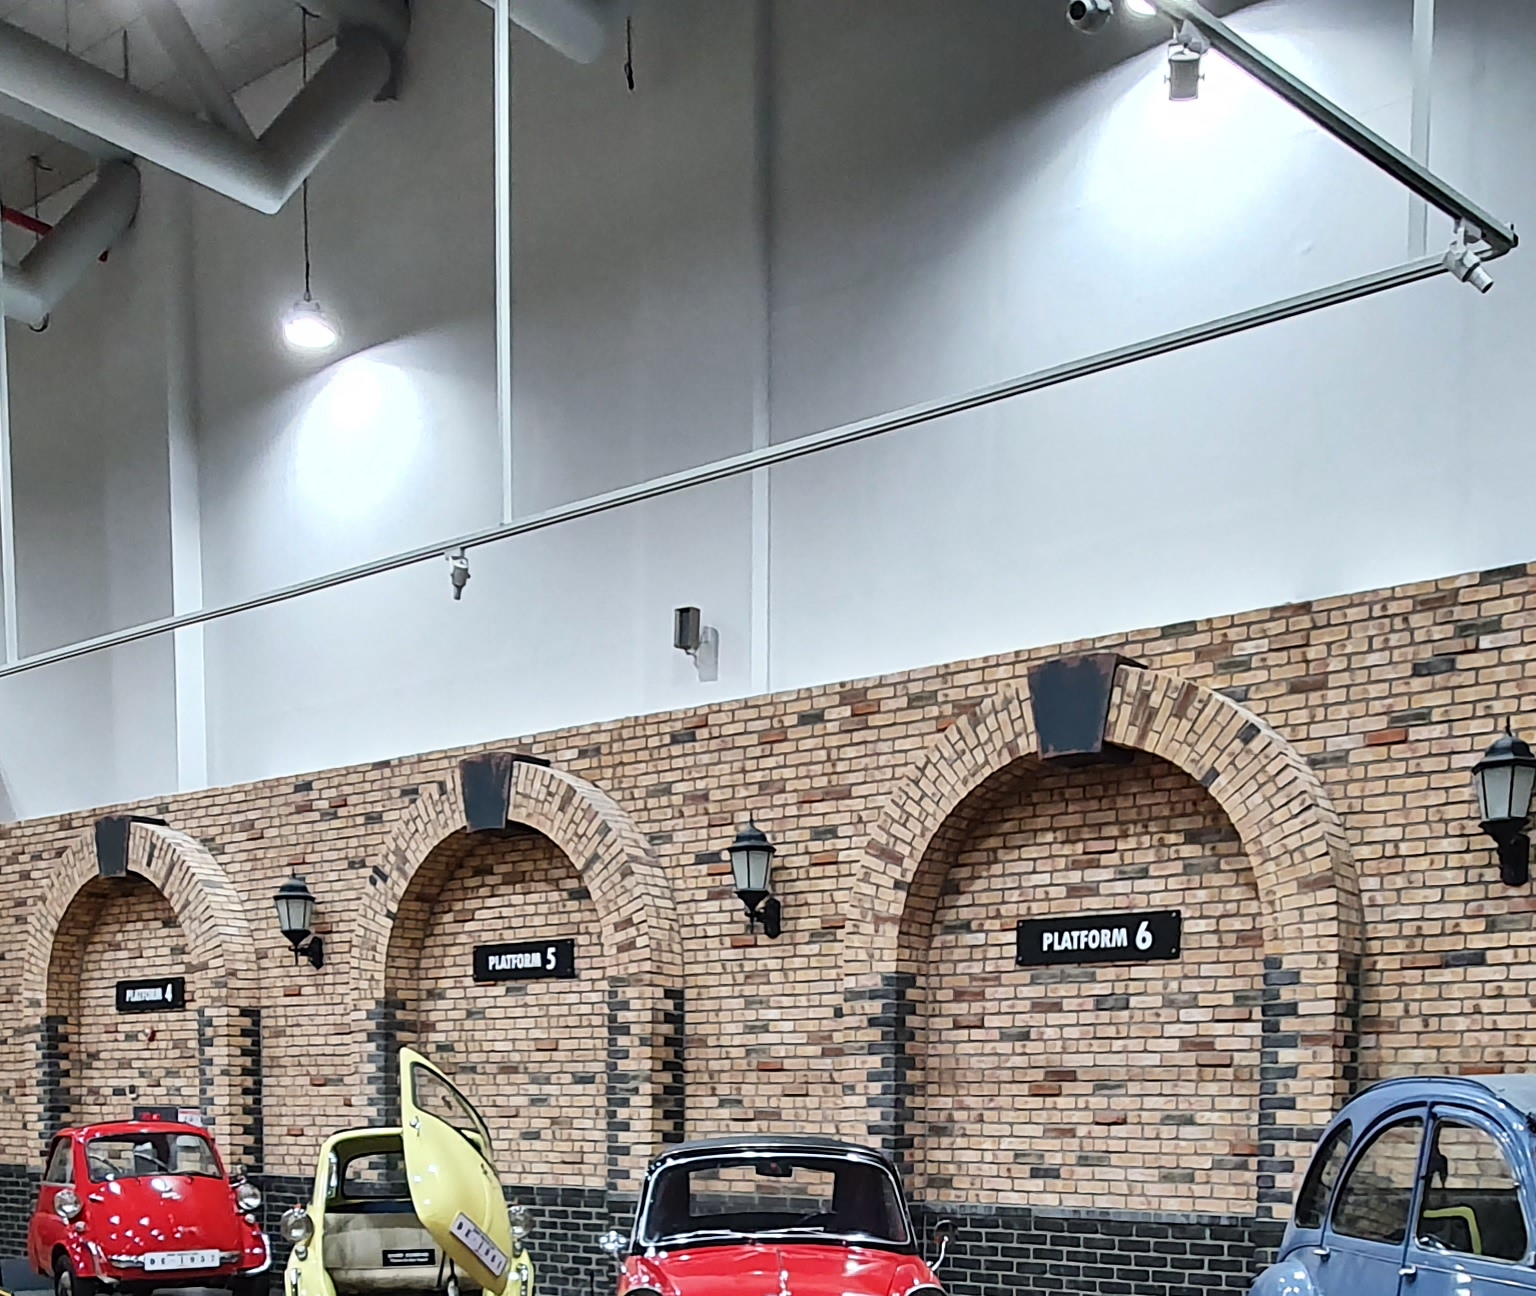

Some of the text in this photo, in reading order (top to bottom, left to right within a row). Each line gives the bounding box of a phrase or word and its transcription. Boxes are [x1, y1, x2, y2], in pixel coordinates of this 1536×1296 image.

[1042, 920, 1153, 952] PLATFORM 6
[488, 946, 557, 971] PLATFORM 5
